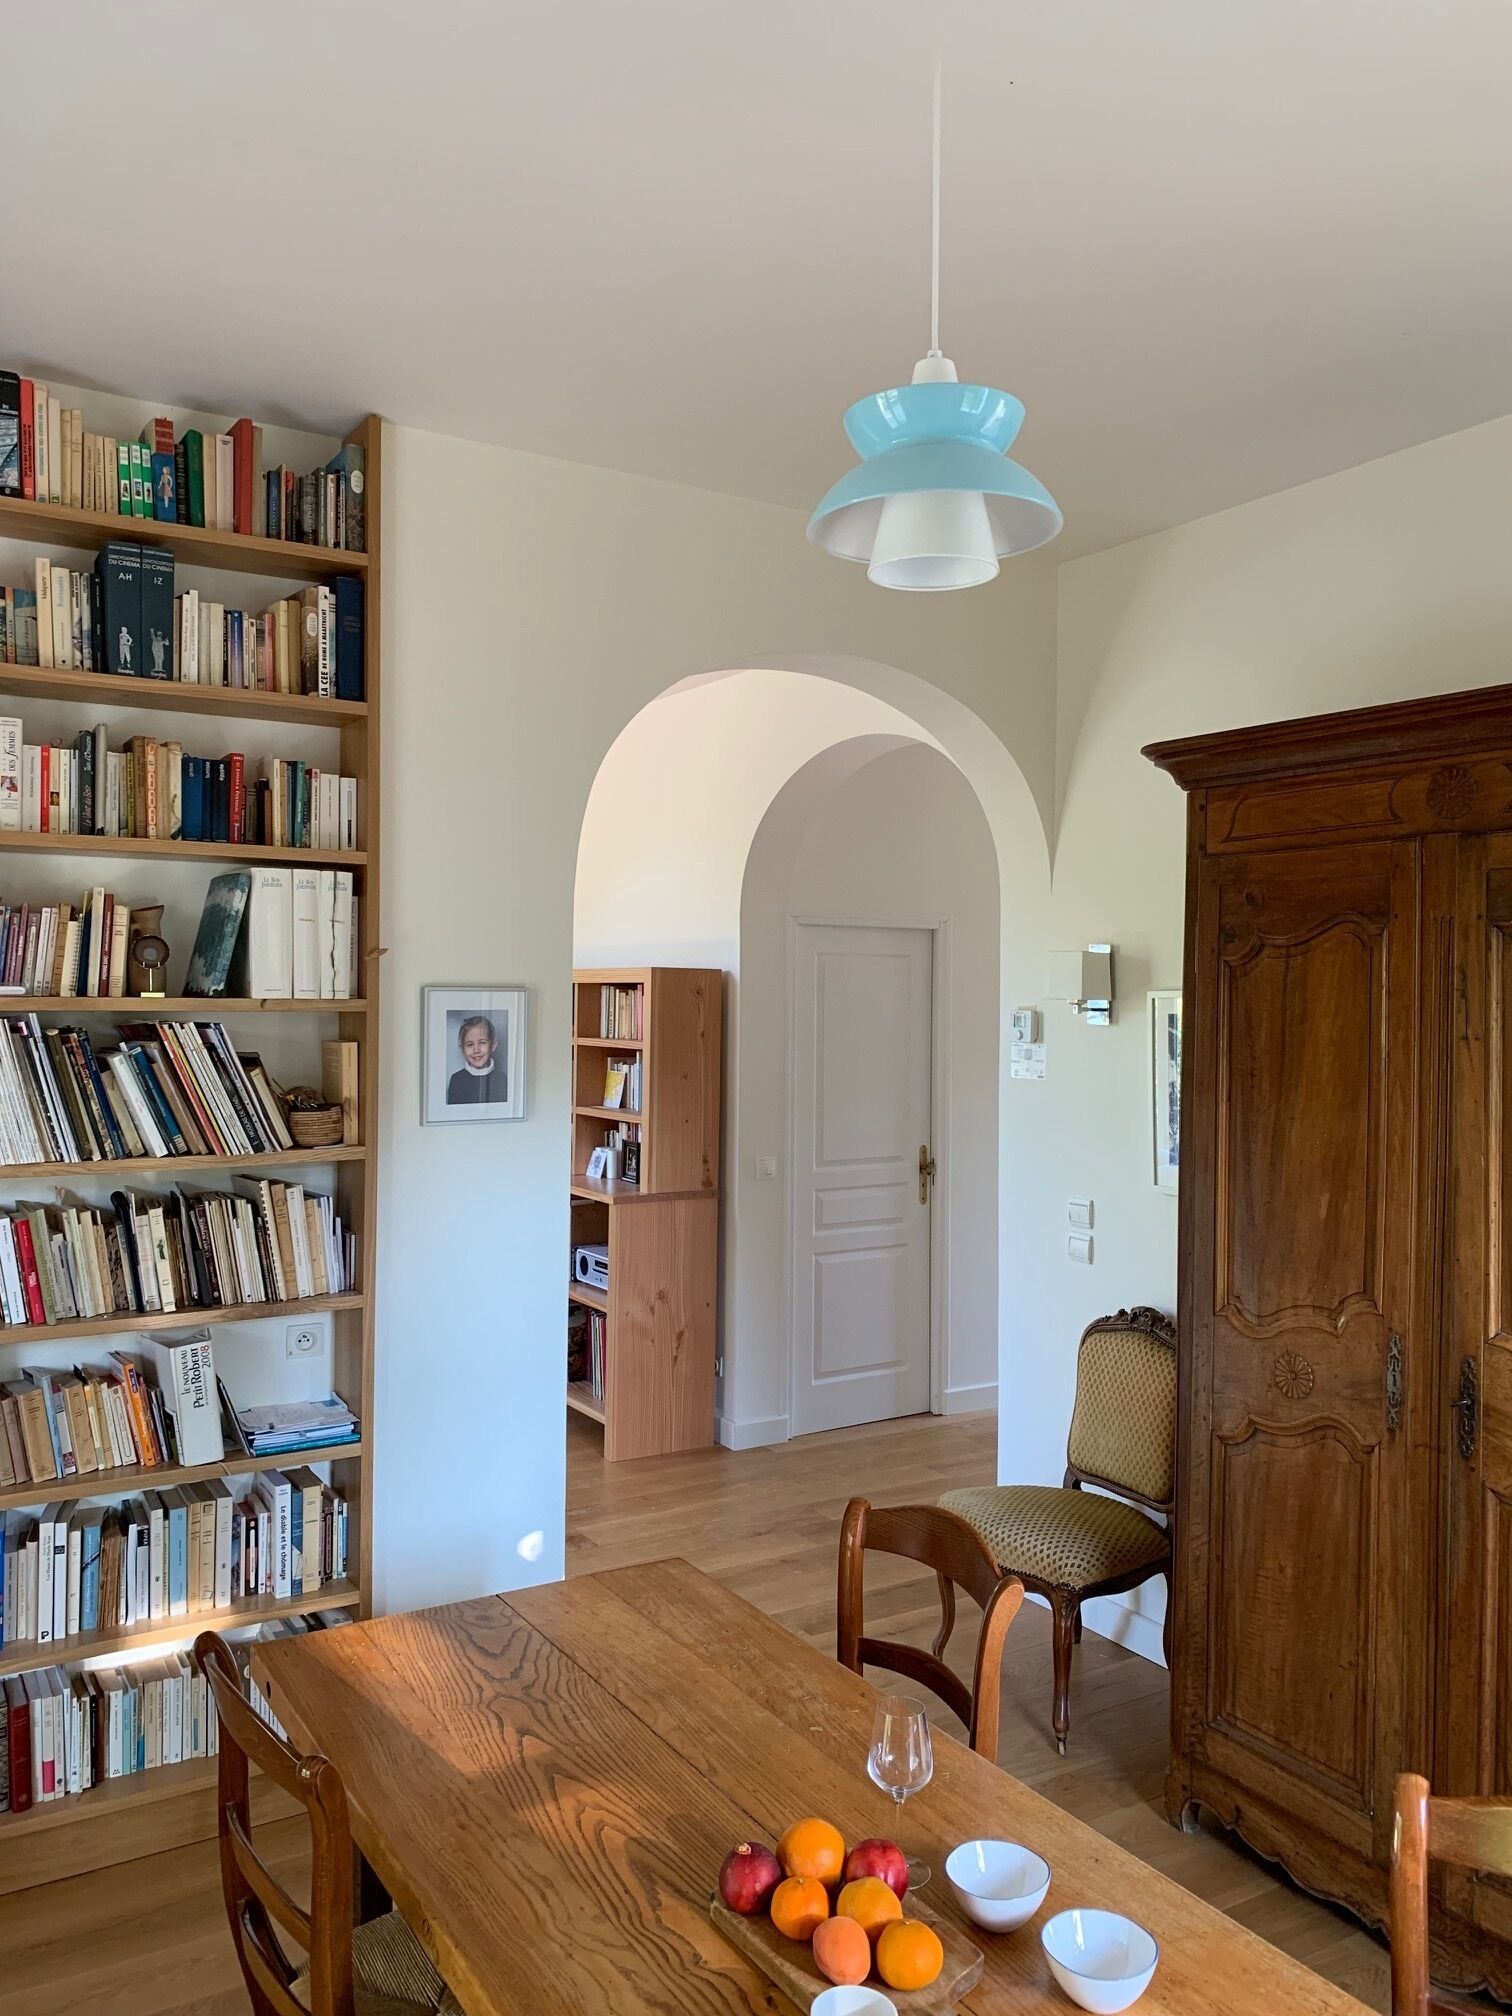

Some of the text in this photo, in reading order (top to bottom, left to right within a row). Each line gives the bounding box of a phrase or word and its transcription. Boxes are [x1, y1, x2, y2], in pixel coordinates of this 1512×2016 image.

[321, 688, 328, 696] LA
[181, 1350, 190, 1386] NOUVEAU
[200, 1345, 211, 1368] 2008
[193, 1385, 204, 1408] PETIT
[280, 1506, 287, 1514] Le
[280, 1552, 288, 1581] chômage
